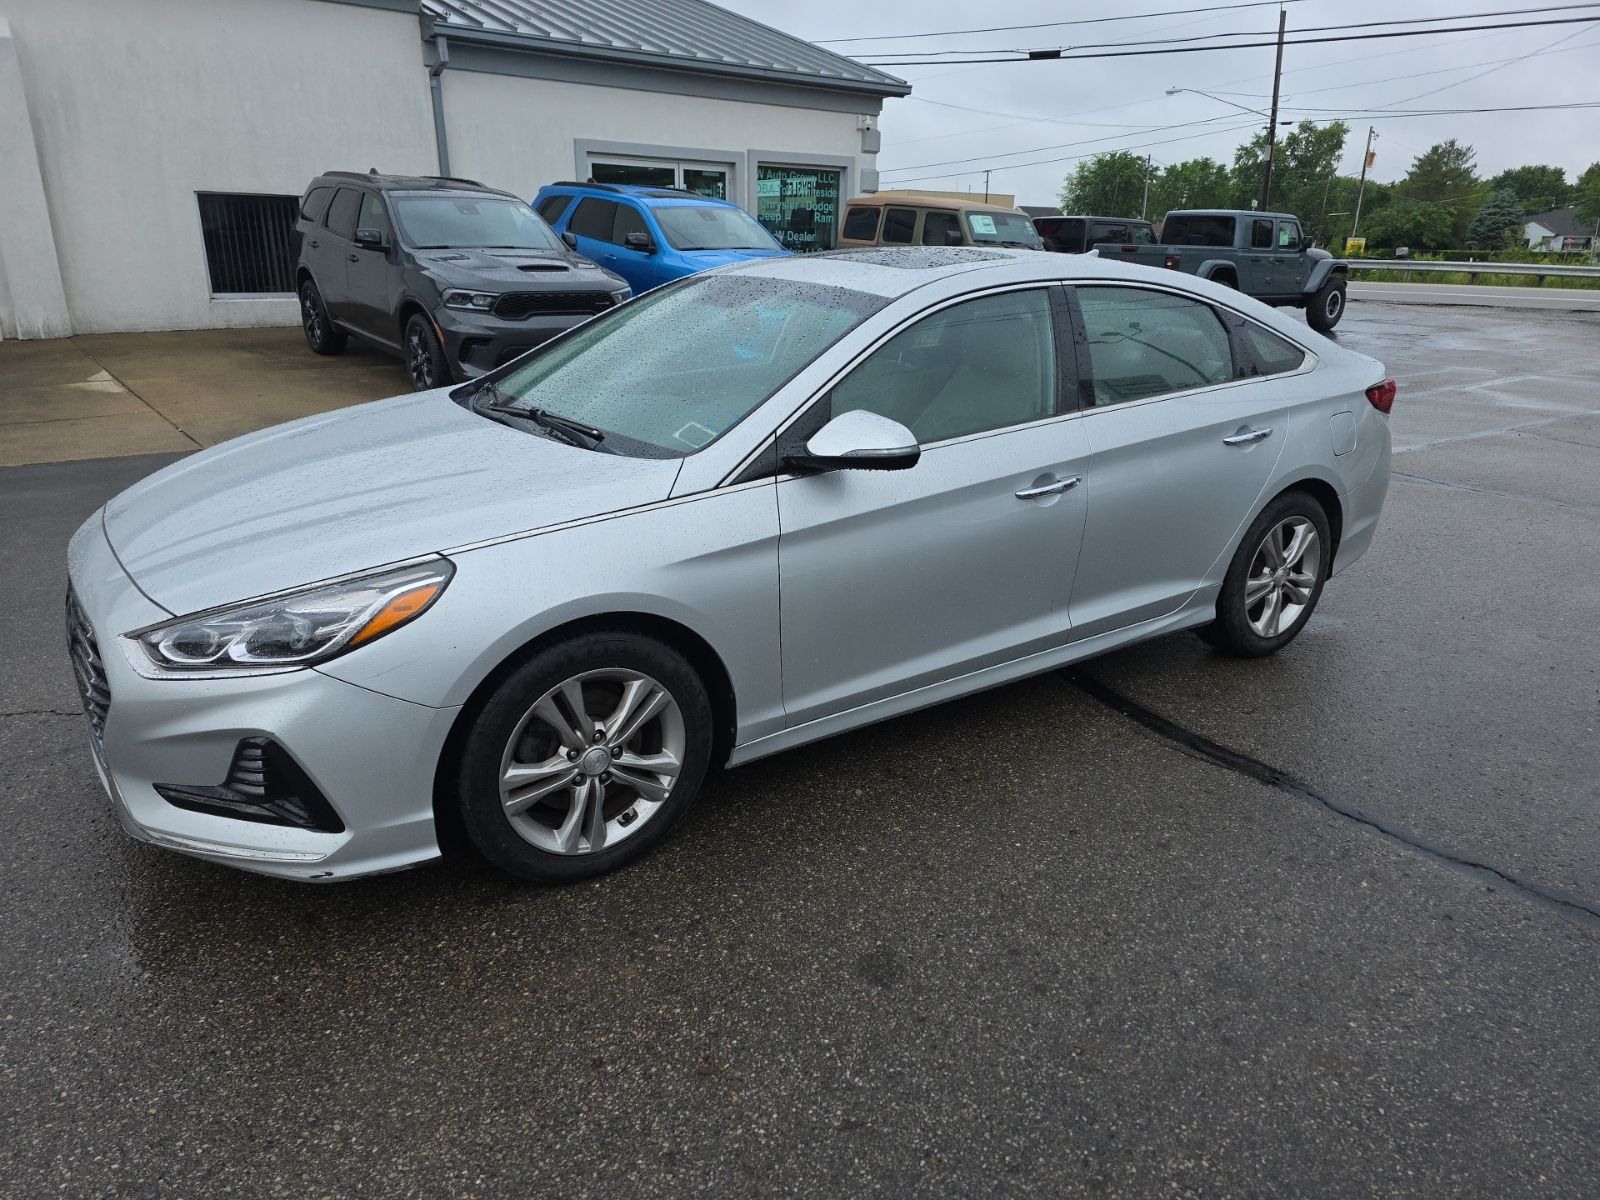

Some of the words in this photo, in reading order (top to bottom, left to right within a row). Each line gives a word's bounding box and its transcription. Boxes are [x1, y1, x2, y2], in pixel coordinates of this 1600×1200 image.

[767, 169, 787, 180] Auto
[806, 201, 833, 213] Dodge
[759, 212, 781, 223] Jeep
[815, 213, 833, 223] Ram
